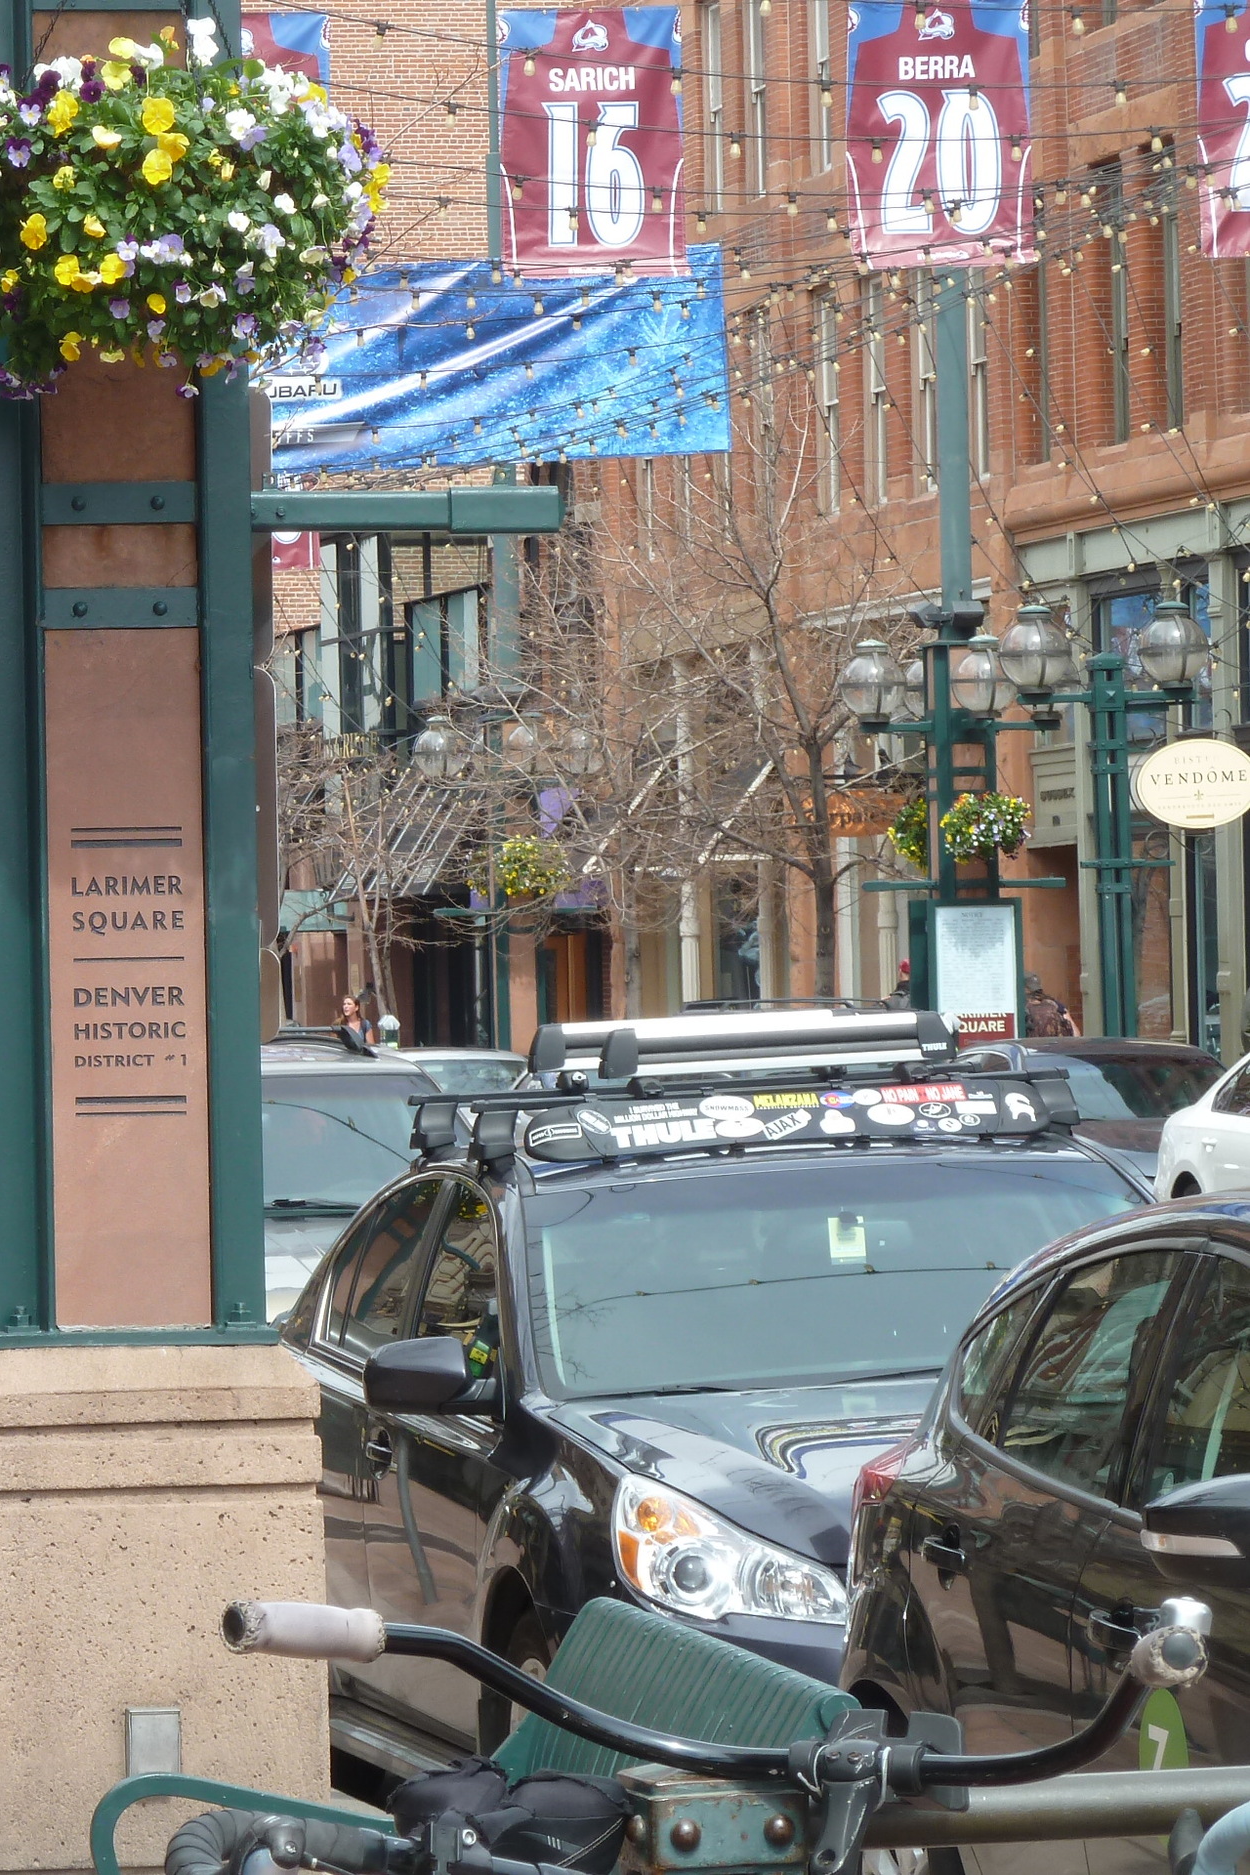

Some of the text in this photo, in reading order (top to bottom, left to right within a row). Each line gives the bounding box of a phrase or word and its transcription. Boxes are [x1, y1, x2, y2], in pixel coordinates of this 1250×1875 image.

[898, 55, 976, 80] BERRA
[549, 66, 636, 92] SARICH
[876, 89, 1002, 235] 20
[541, 101, 645, 248] 16
[1150, 766, 1248, 786] VENDÔME
[71, 875, 183, 897] LARIMER
[72, 910, 185, 936] SQUARE
[73, 986, 185, 1008] DENVER
[74, 1021, 187, 1041] HISTORIC
[922, 1043, 947, 1051] THULE
[75, 1054, 154, 1068] DISTRICT
[882, 1088, 897, 1103] NO
[897, 1088, 920, 1102] PAIN
[925, 1086, 941, 1101] NO
[941, 1085, 967, 1100] JANE
[611, 1118, 718, 1149] THULE
[764, 1115, 801, 1138] AJAX
